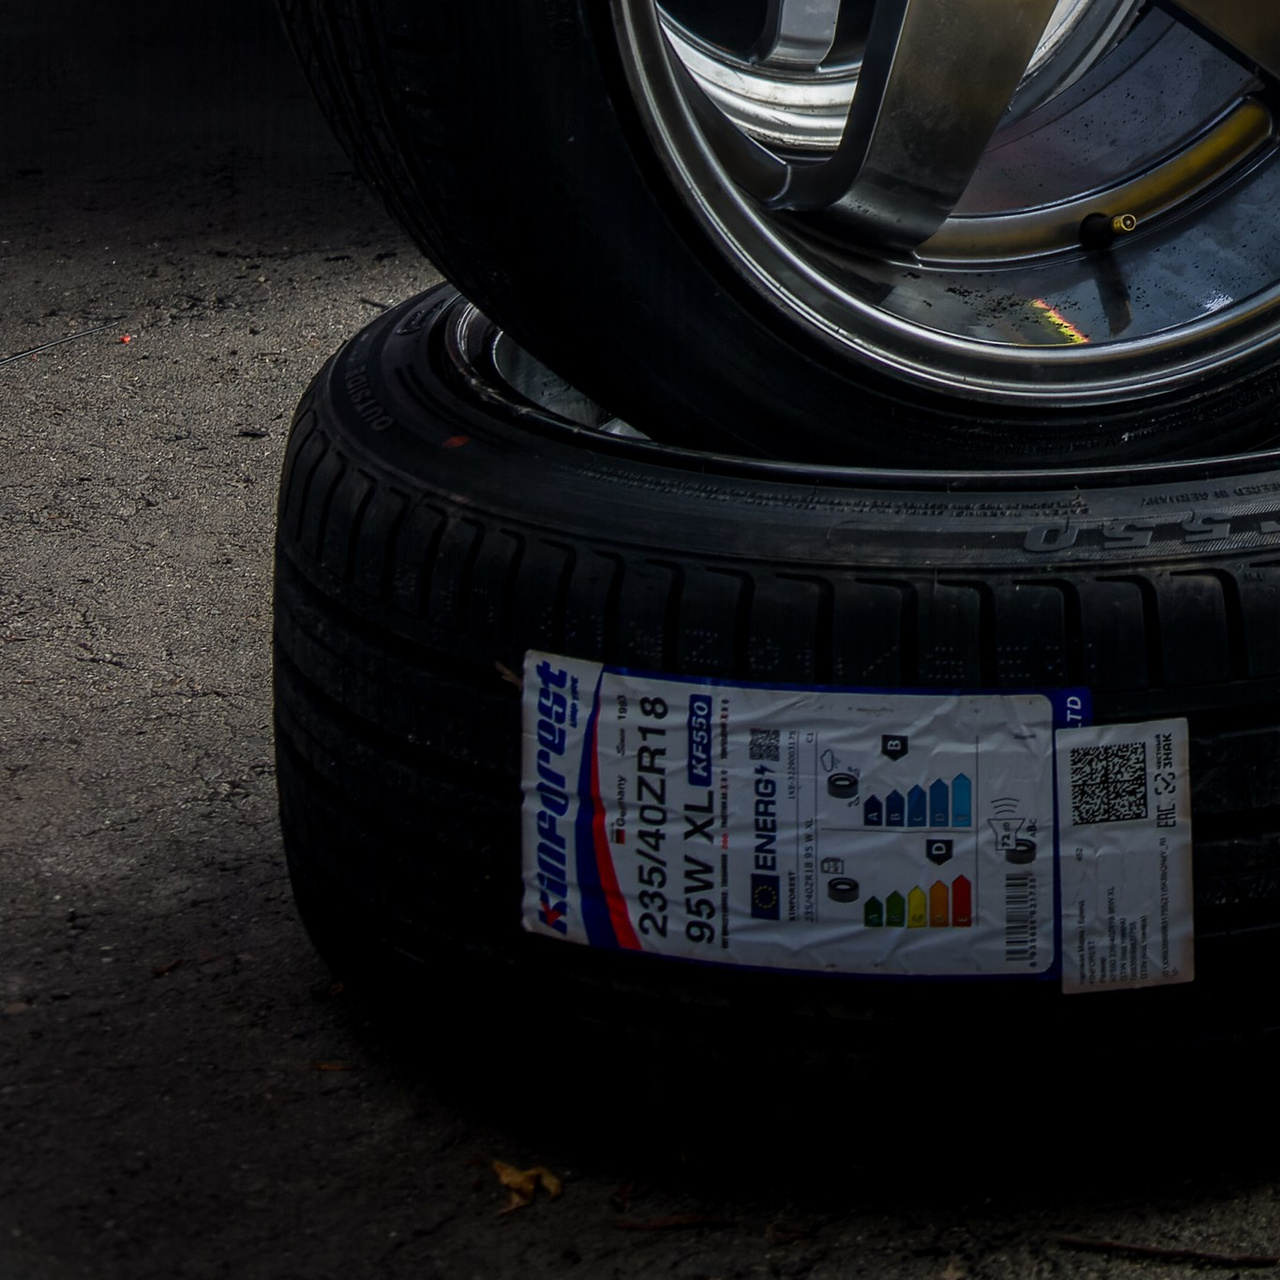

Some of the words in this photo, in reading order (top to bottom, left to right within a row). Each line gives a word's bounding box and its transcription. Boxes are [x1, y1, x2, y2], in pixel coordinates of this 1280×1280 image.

[616, 695, 626, 720] 1993
[692, 701, 708, 778] KF550
[887, 740, 900, 750] B
[1163, 733, 1173, 769] ЗНАК
[615, 775, 627, 827] Germany
[637, 696, 668, 938] 235/40ZR18
[684, 790, 713, 842] XL
[754, 779, 776, 871] ENERG
[932, 842, 944, 854] D
[1002, 834, 1010, 847] 72
[684, 855, 715, 944] 95W
